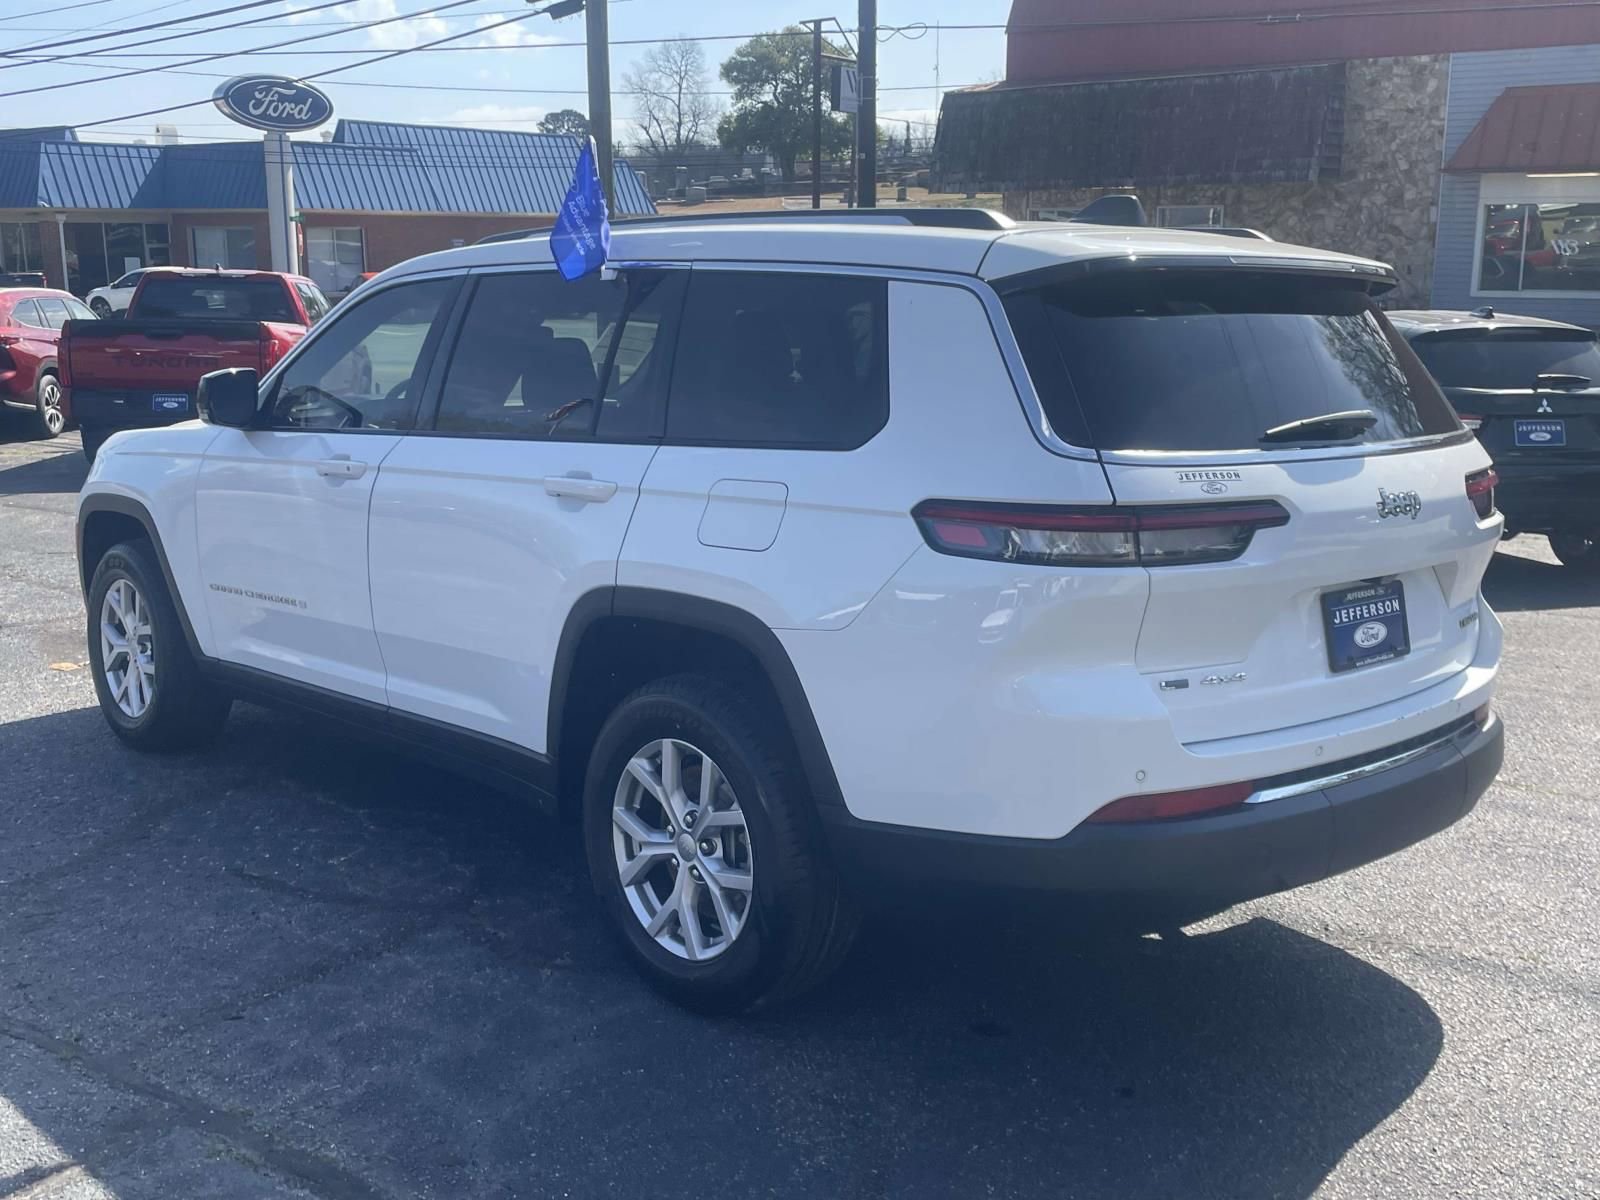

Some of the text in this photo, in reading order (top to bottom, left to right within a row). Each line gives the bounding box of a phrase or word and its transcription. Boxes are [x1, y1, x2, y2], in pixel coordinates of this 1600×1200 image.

[248, 85, 313, 120] Ford
[575, 194, 590, 217] Blue
[567, 200, 596, 251] Advantage
[1517, 424, 1562, 432] JEFFERSON
[1178, 471, 1241, 481] JEFFERSON
[1376, 487, 1421, 520] Jeep
[1333, 599, 1401, 624] JEFFERSON
[1360, 625, 1382, 644] Ford
